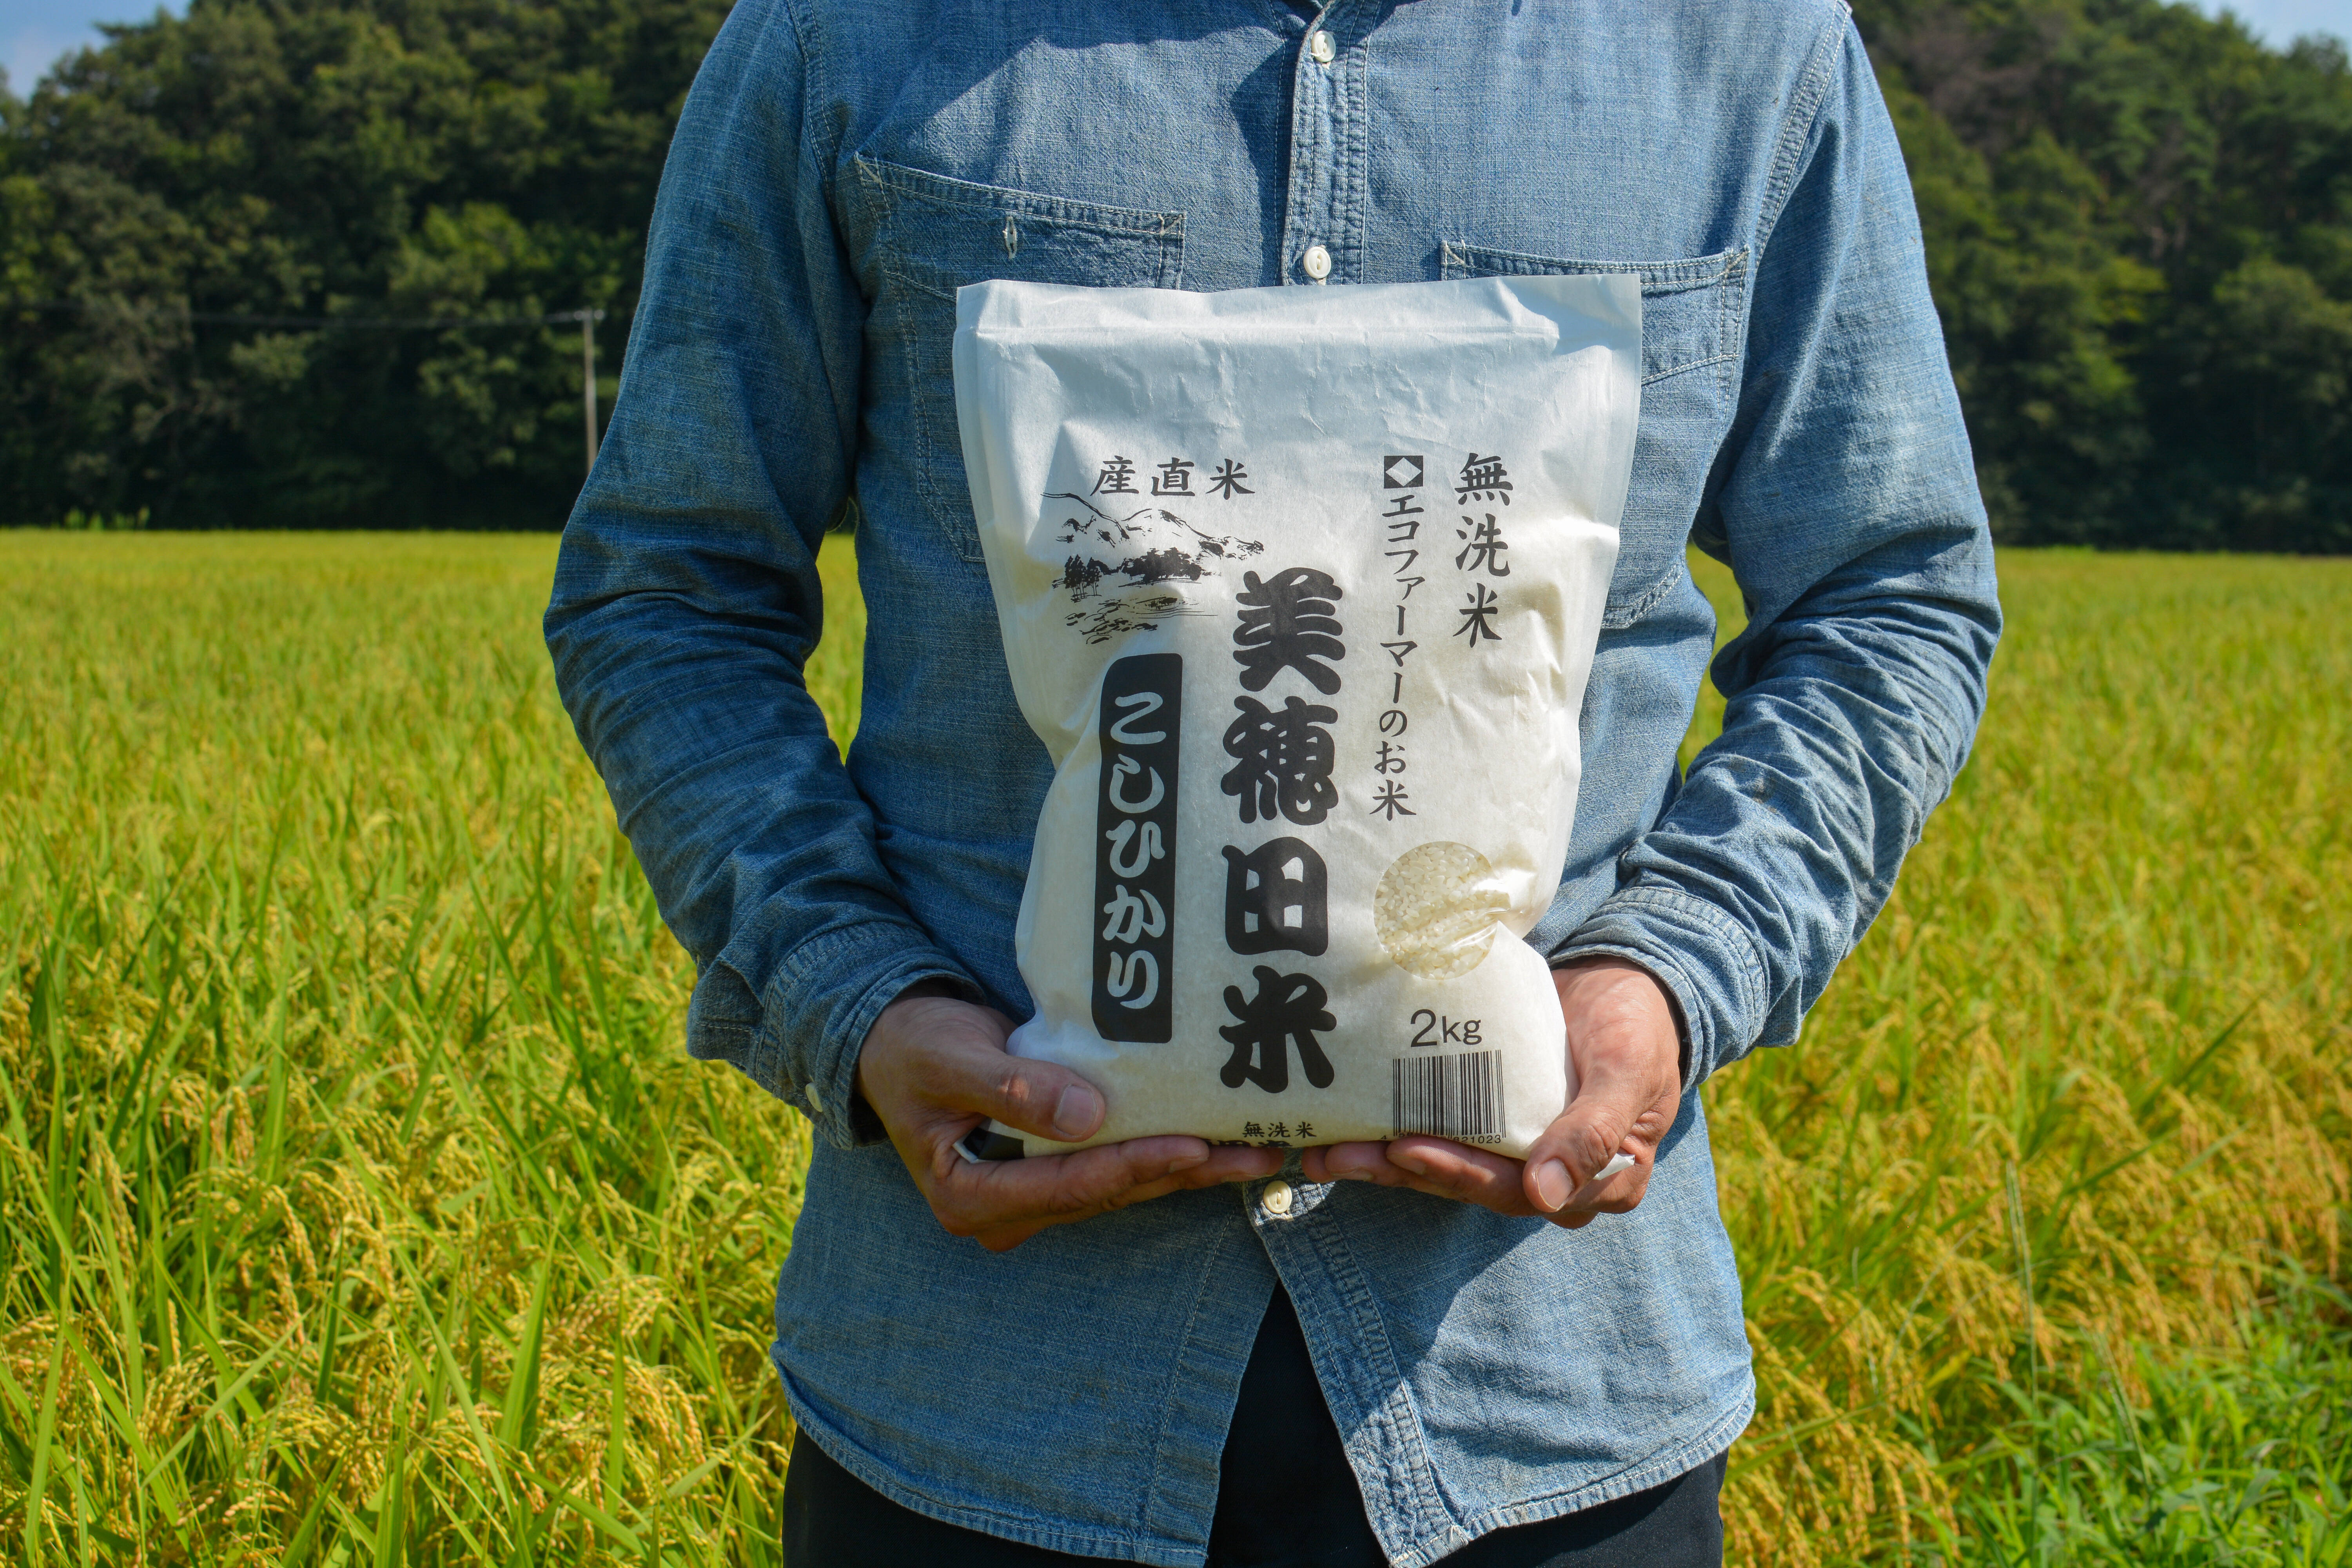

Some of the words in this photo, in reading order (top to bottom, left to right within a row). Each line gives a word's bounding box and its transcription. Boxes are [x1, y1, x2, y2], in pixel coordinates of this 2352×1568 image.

[1090, 455, 1256, 500] 産直米
[1452, 452, 1514, 648] 無洗米
[1369, 494, 1425, 821] エコファーマーのお米
[1102, 691, 1167, 1009] こしひかり
[1219, 566, 1346, 1094] 美穂田米
[1410, 1009, 1483, 1047] 2kg
[1242, 1121, 1317, 1139] 無洗米
